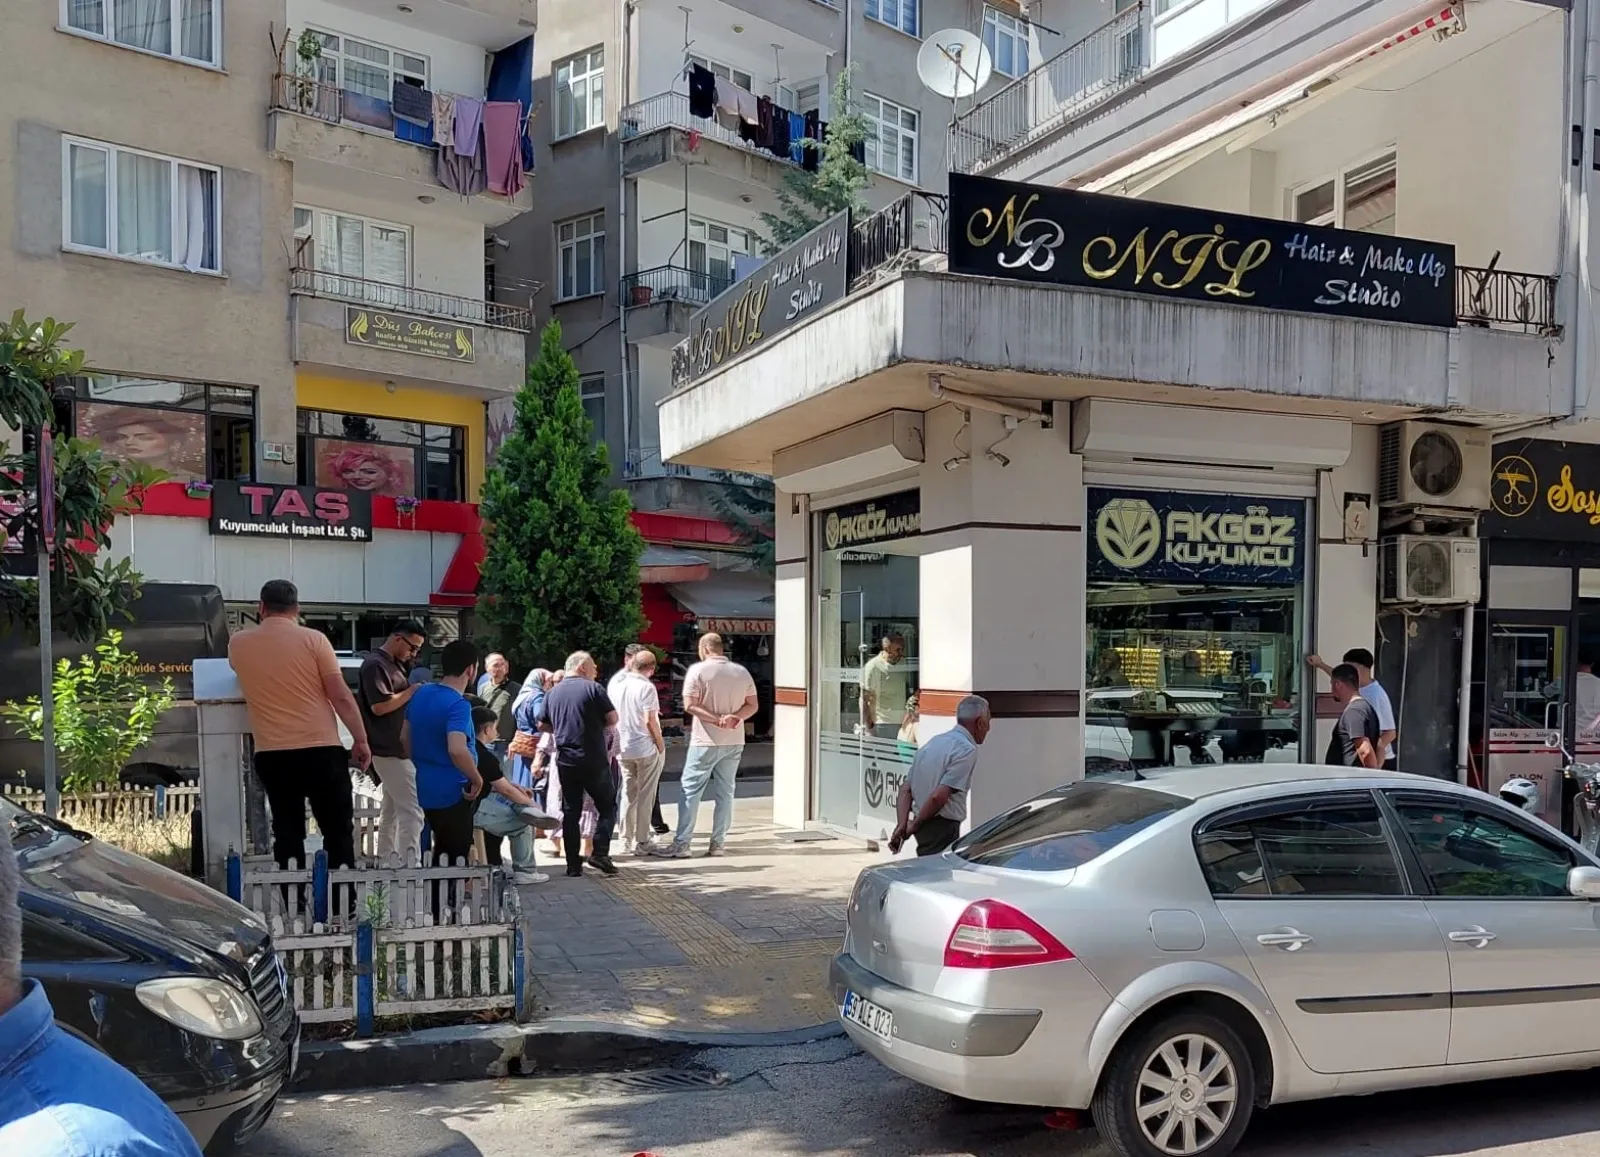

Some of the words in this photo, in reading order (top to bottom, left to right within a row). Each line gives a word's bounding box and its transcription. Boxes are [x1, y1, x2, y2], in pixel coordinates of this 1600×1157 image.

[772, 261, 793, 289] Hair
[800, 236, 825, 283] Make
[826, 229, 842, 264] Up
[1083, 224, 1271, 297] NİL
[1284, 233, 1335, 263] Hair
[1339, 246, 1355, 266] &
[1361, 245, 1414, 277] Make
[1418, 252, 1446, 287] Up
[786, 280, 823, 320] Studio
[1314, 279, 1401, 308] Studio
[373, 315, 401, 332] Düş
[240, 486, 350, 525] TAŞ
[840, 503, 887, 543] AKGÖZ
[219, 519, 289, 534] Kuyumculuk
[292, 520, 325, 537] İnşaat
[328, 525, 348, 537] Ltd.
[1166, 505, 1296, 546] AKGÖZ
[1166, 542, 1294, 567] KUYUMCU
[708, 619, 738, 633] BAY
[858, 1002, 874, 1028] ALE
[874, 1010, 891, 1036] 023
